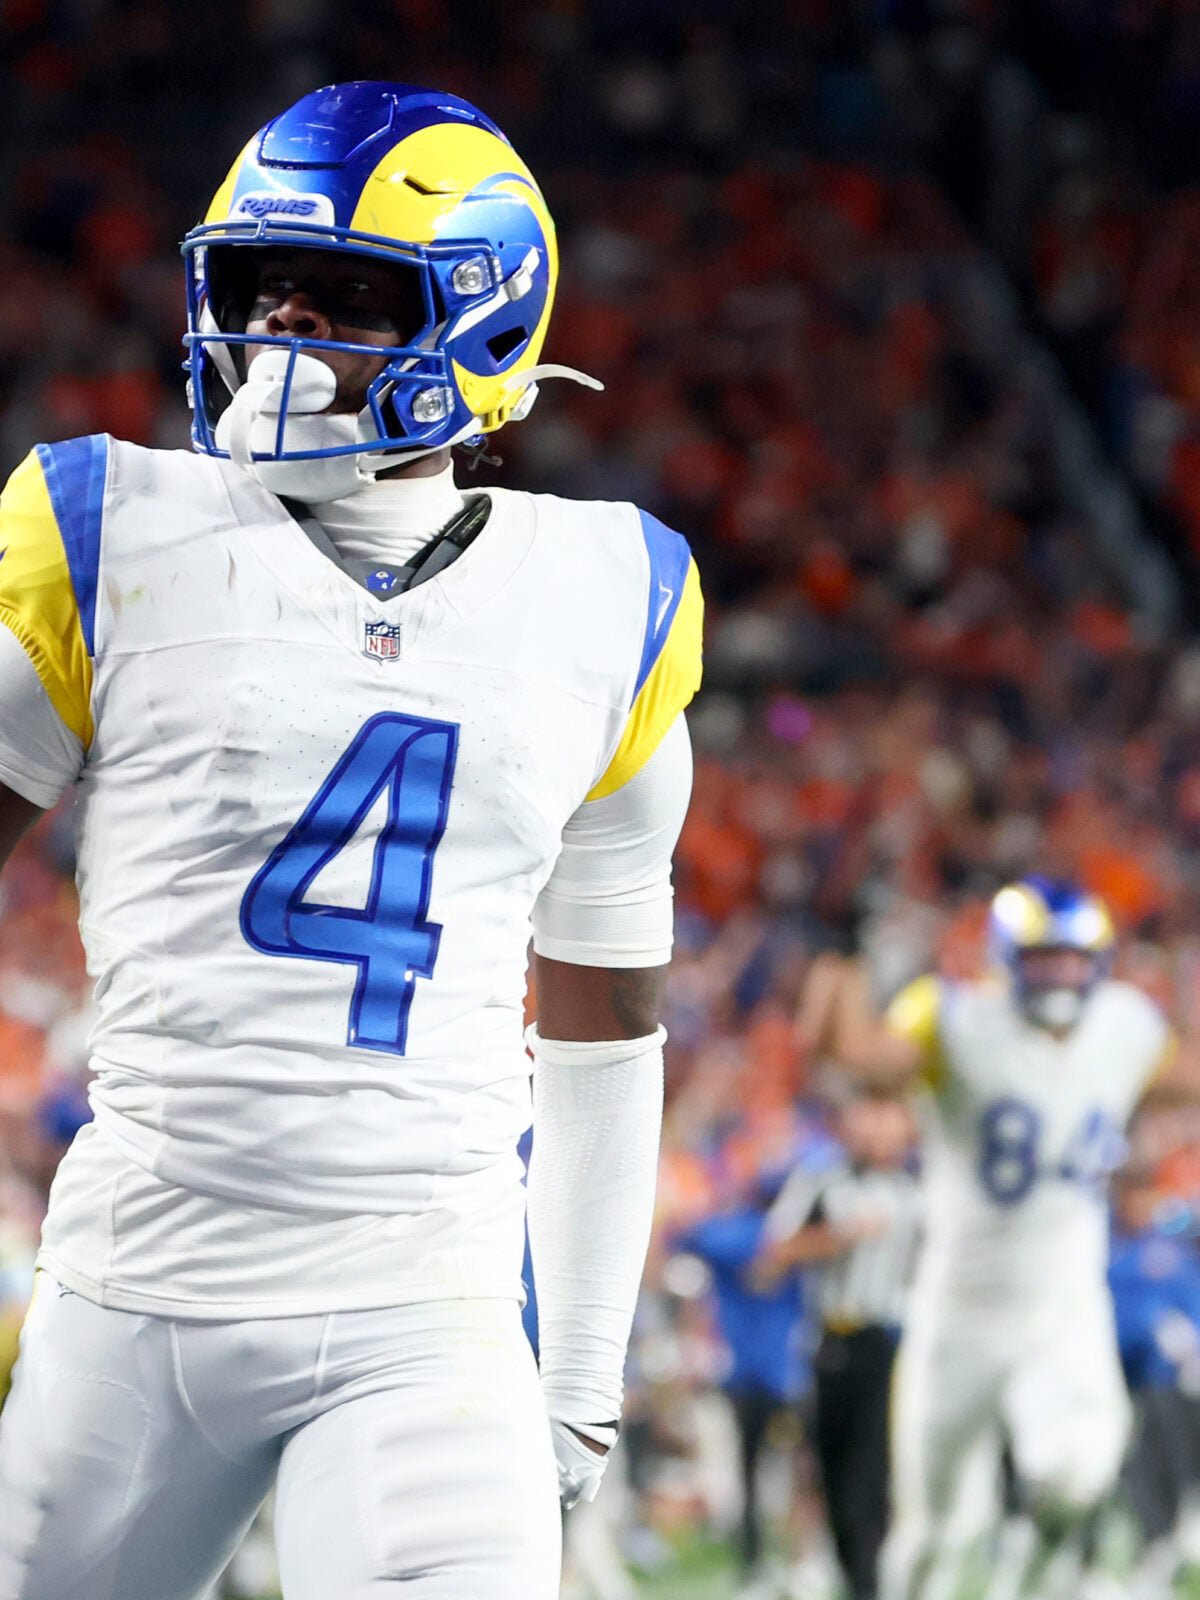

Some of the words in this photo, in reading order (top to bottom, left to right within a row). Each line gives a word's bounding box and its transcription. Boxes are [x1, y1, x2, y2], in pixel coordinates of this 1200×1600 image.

[239, 198, 318, 218] RAMS
[368, 636, 397, 655] NFL
[239, 710, 461, 1056] 4
